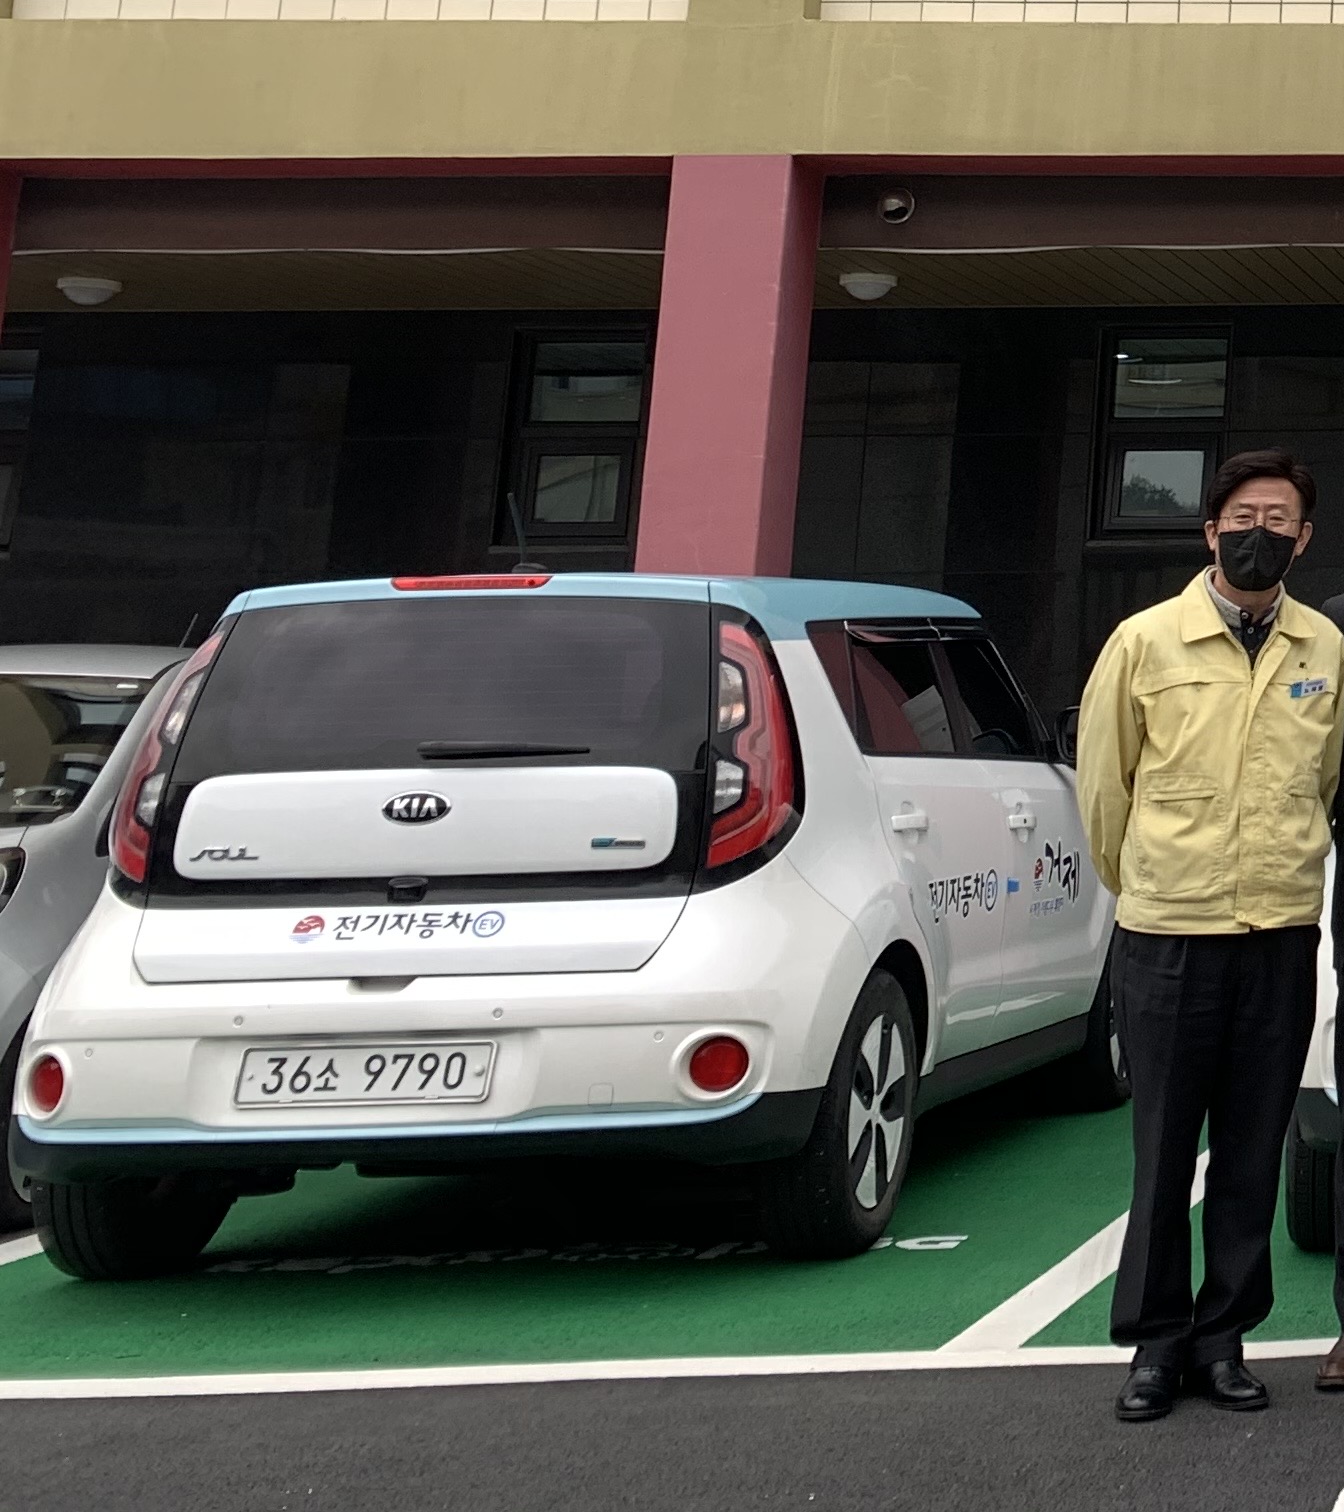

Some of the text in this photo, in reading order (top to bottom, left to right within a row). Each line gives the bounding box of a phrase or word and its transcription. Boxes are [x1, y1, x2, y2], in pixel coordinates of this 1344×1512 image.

[392, 796, 440, 819] KIA
[333, 911, 472, 941] 전기자동차
[261, 1051, 467, 1095] 36소 9790
